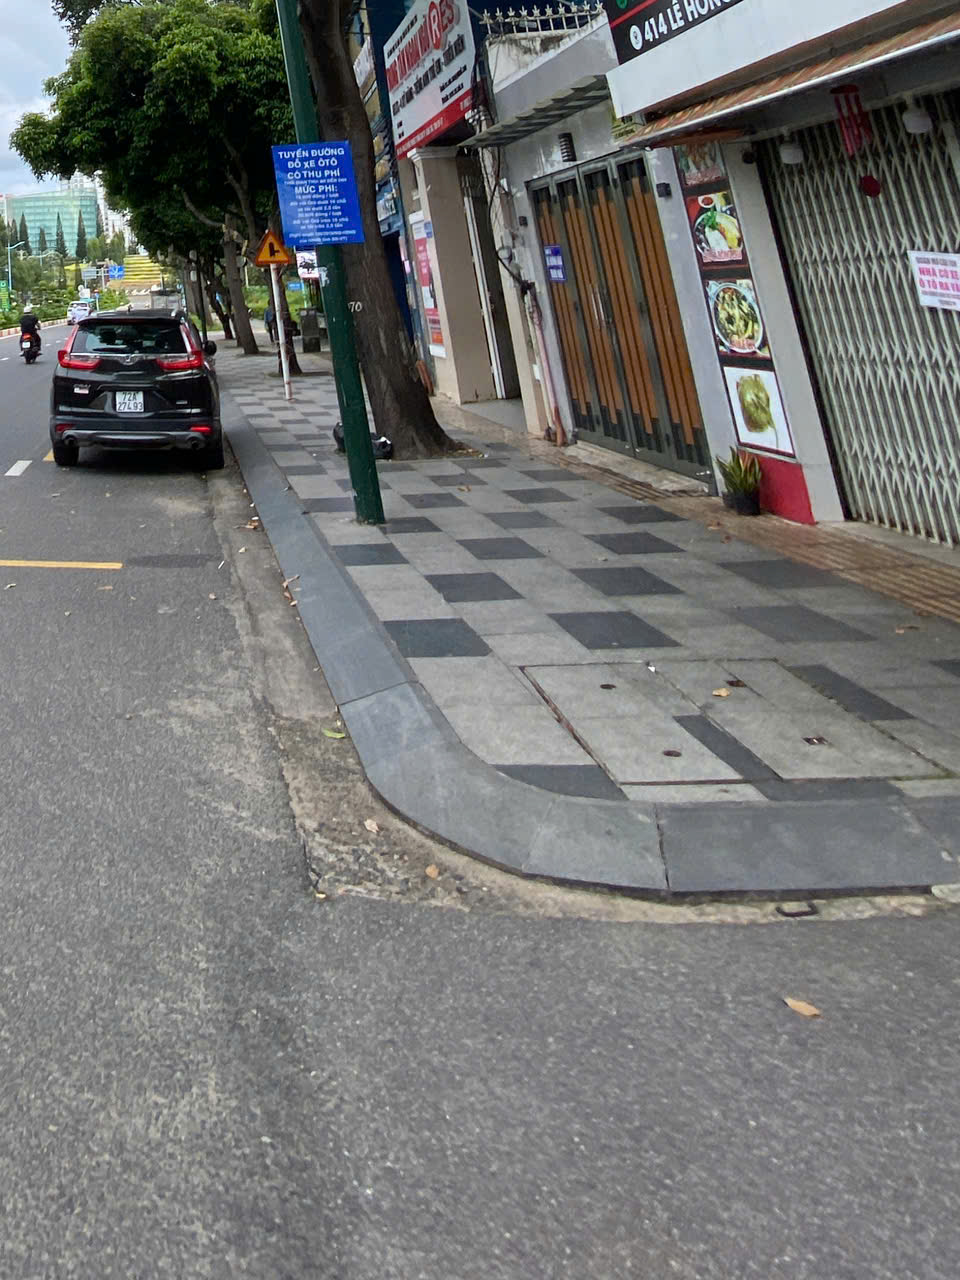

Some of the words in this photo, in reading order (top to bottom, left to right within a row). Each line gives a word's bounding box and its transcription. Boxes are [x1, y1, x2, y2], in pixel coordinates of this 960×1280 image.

[644, 12, 667, 42] 414
[303, 160, 315, 169] XE
[302, 170, 321, 178] THU
[324, 168, 340, 178] PHÍ
